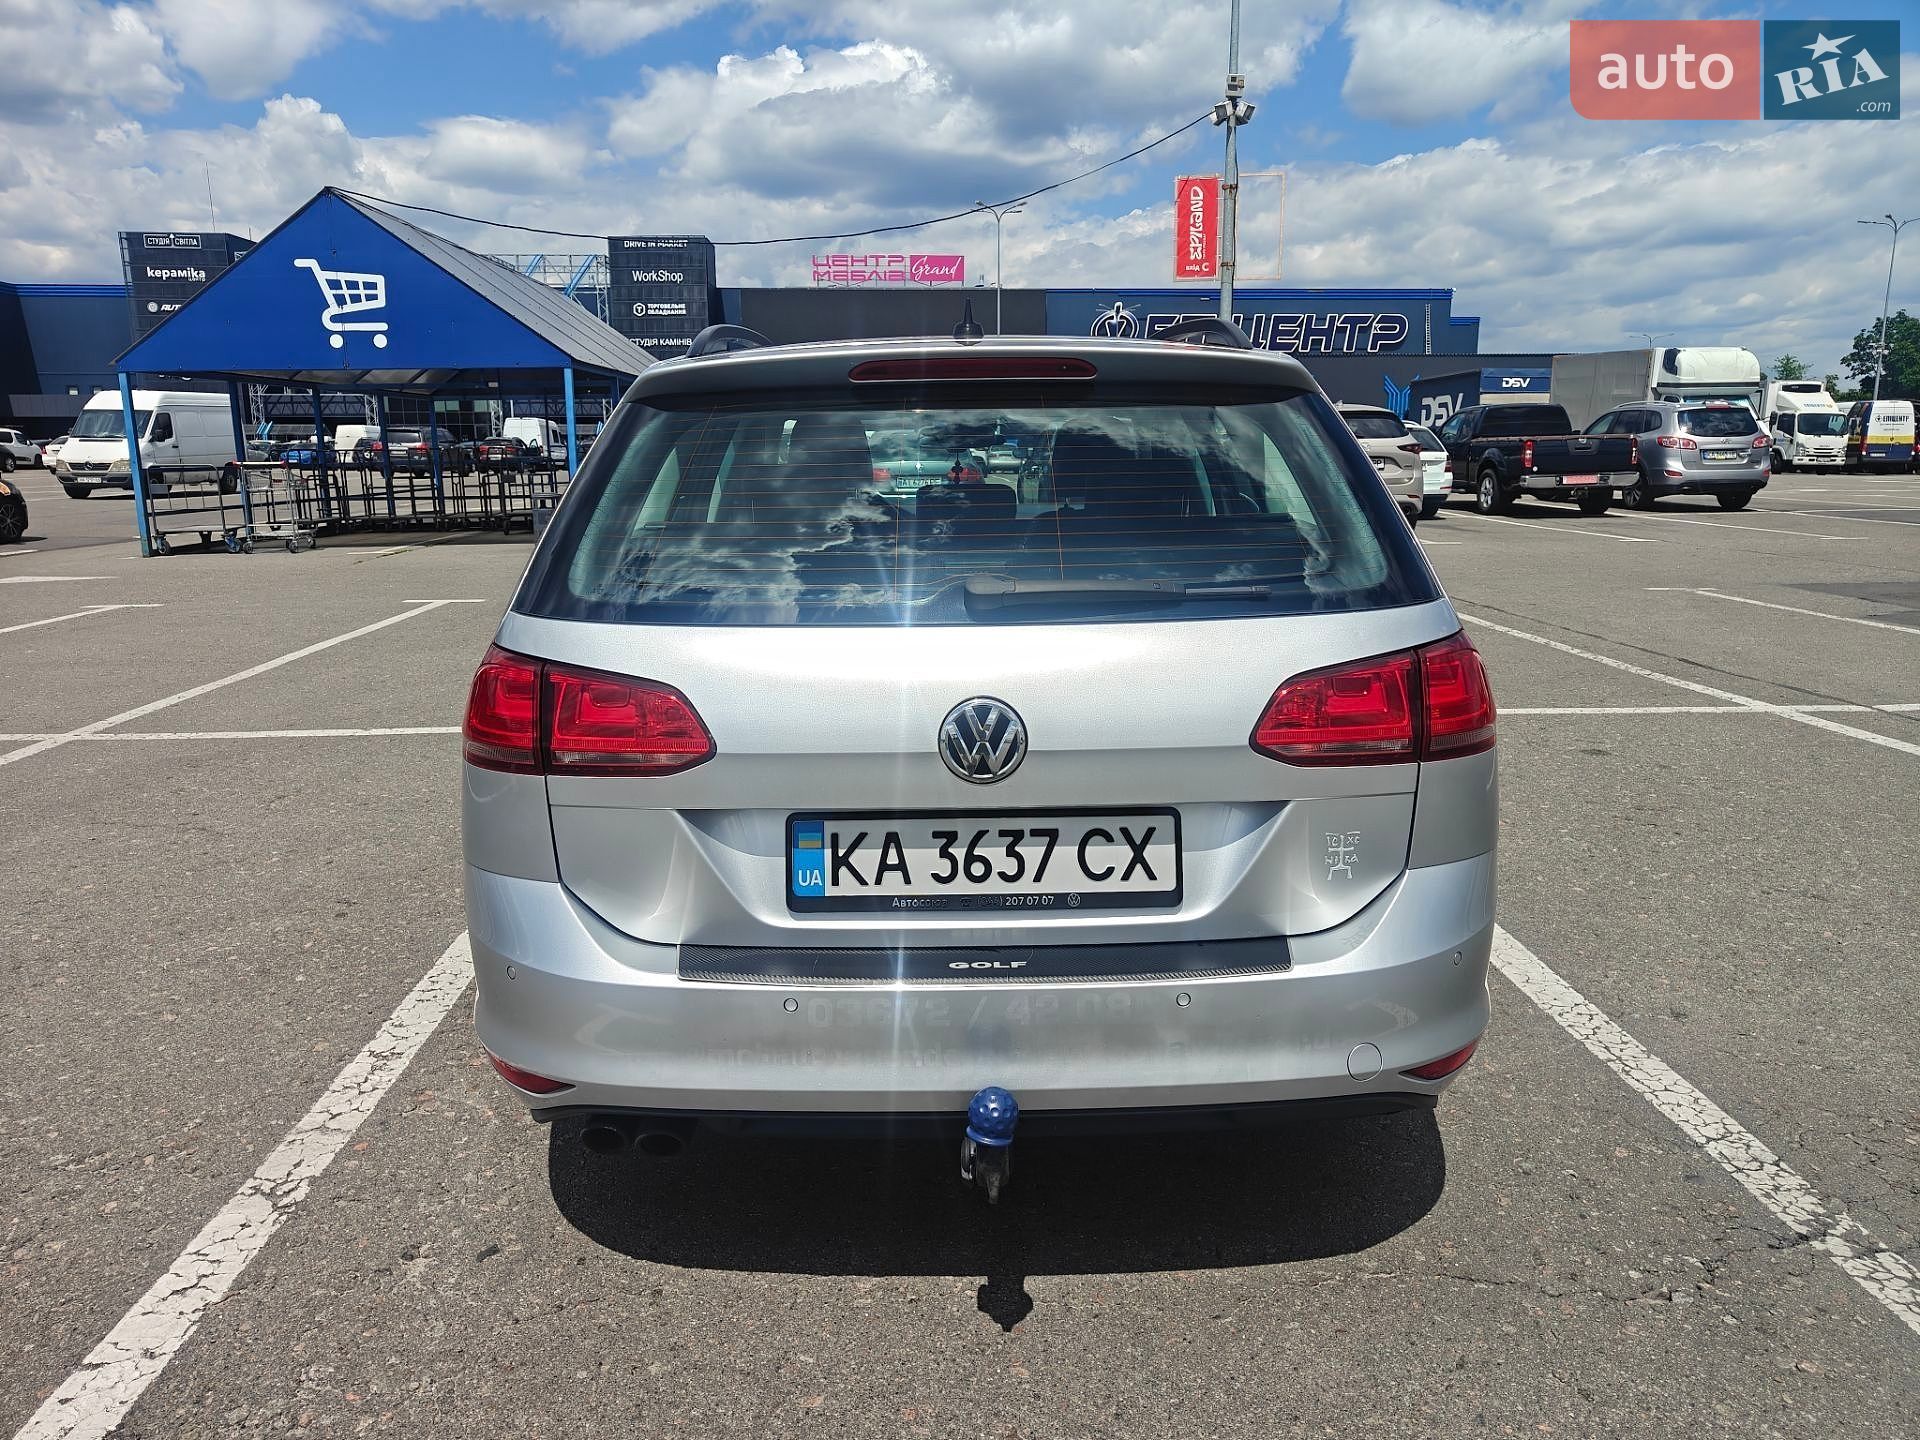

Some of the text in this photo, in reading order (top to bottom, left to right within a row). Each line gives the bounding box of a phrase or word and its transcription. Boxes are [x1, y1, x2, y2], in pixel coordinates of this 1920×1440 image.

[147, 237, 198, 246] СТУДІЯ СВІТЛА
[623, 240, 647, 248] DRIVE
[812, 254, 905, 269] ЦЕНТР
[911, 256, 962, 280] Grand
[632, 270, 684, 284] WorkShop
[659, 337, 693, 346] КАМІНІВ
[1501, 377, 1531, 388] DSV
[1420, 392, 1464, 428] DSV
[831, 826, 1158, 887] KA 3637 CX
[798, 869, 823, 887] UA
[1005, 896, 1024, 906] 207
[1026, 896, 1039, 906] 07
[1041, 895, 1055, 905] 07
[948, 961, 1028, 969] GOLF
